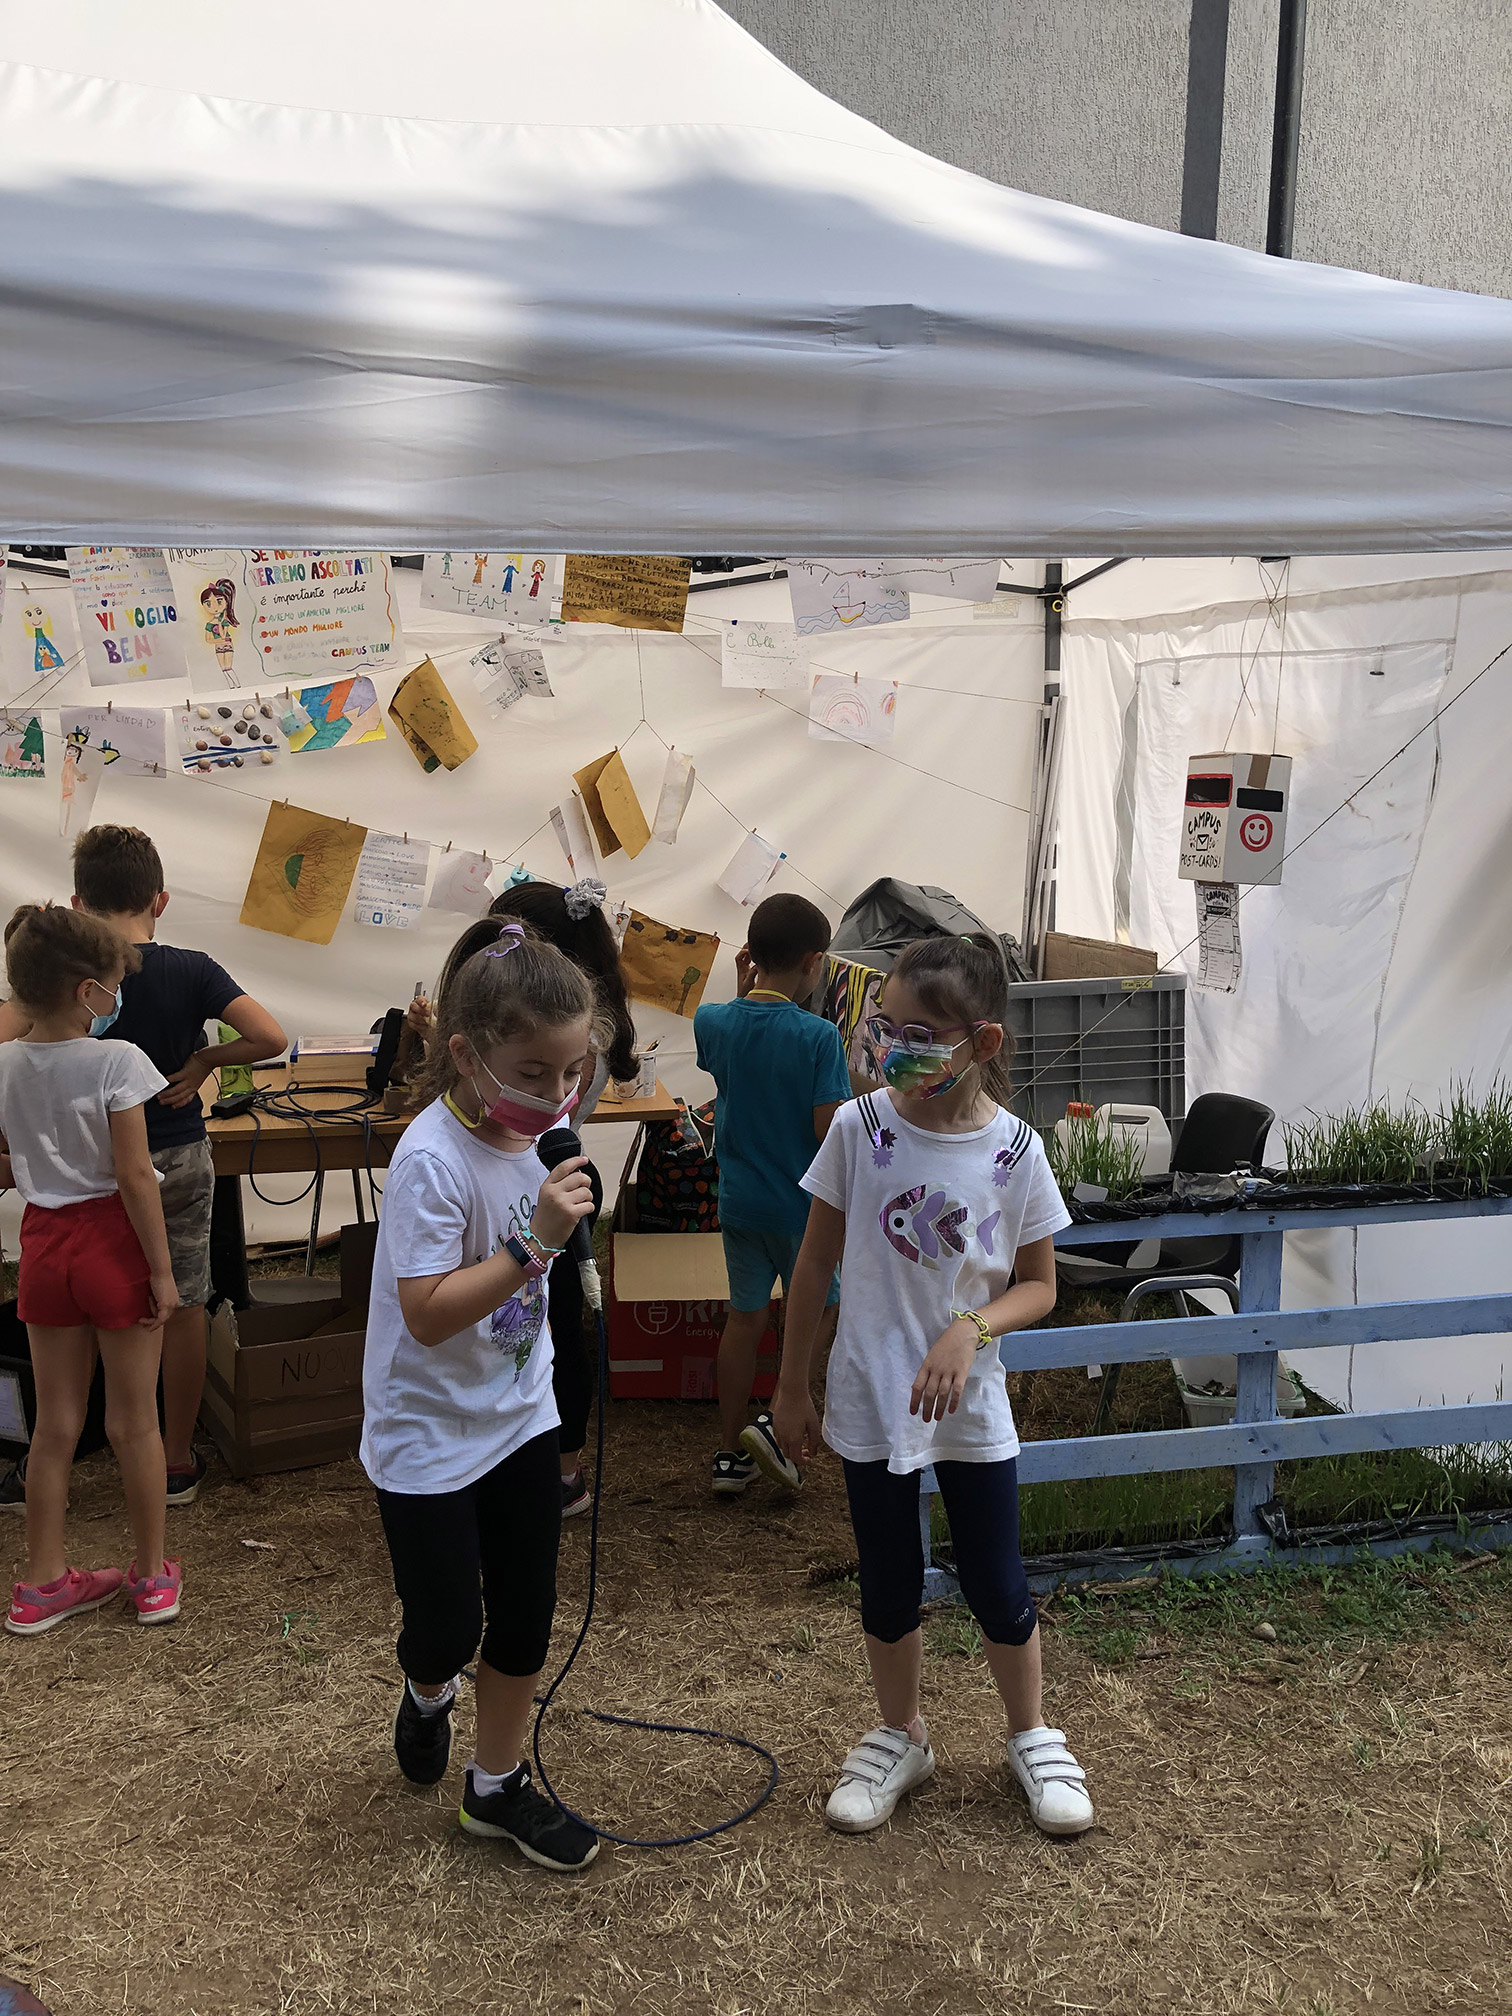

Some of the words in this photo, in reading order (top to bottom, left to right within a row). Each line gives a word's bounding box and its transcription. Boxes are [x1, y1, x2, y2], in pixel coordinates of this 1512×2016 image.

[249, 563, 306, 588] VERREMO
[310, 556, 373, 580] ASCOLTATI
[273, 587, 325, 605] importante
[452, 585, 508, 613] TEAM
[96, 611, 116, 632] VI
[124, 605, 177, 628] VOGLIO
[284, 625, 308, 636] MONDO
[331, 645, 367, 658] CAMPUS
[369, 643, 390, 654] TEAM
[87, 714, 108, 722] PER
[116, 715, 143, 728] LINDA
[1187, 810, 1221, 835] CAMPUS
[1179, 853, 1221, 869] POST-CARDS!
[1205, 890, 1229, 904] CAMPUS
[358, 910, 408, 928] LOVE
[685, 1326, 720, 1340] Energy
